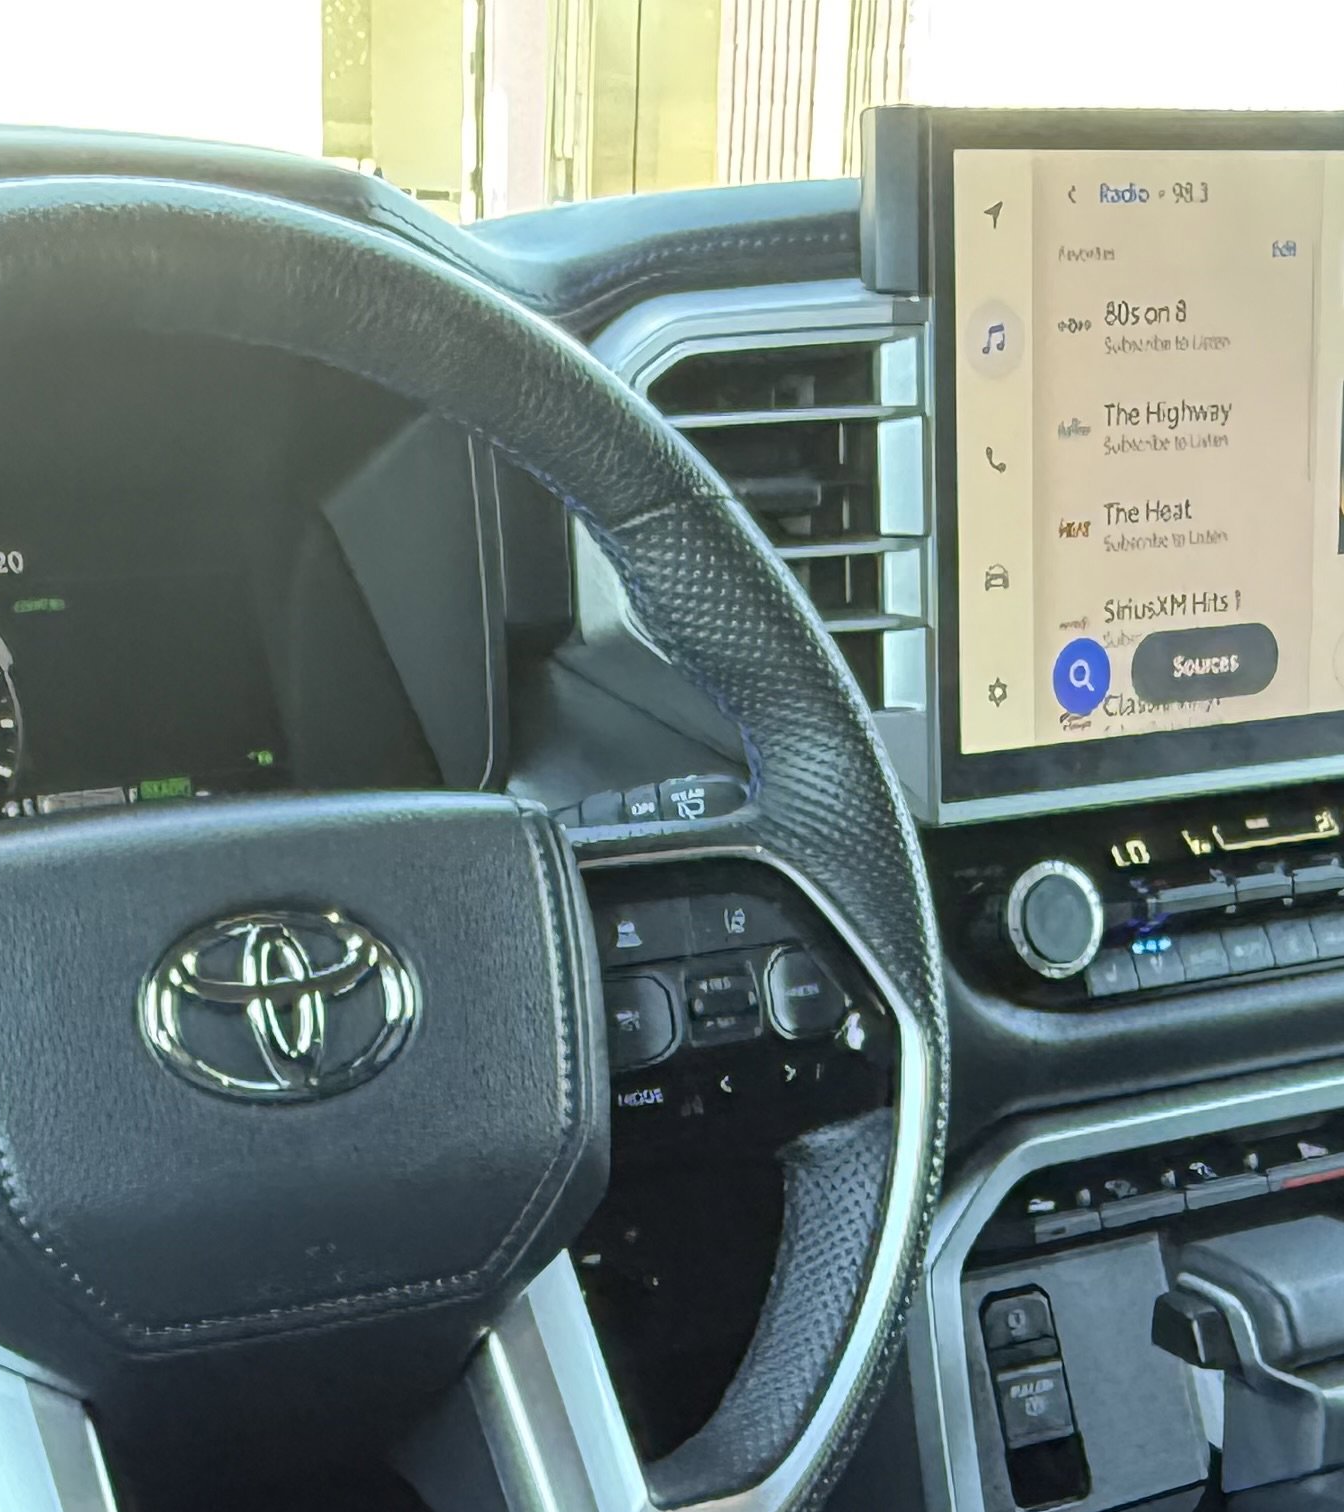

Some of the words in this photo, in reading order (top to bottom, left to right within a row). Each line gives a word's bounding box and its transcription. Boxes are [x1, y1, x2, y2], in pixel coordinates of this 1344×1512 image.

[1099, 181, 1150, 204] Radio
[1104, 300, 1141, 327] 80s
[1143, 305, 1171, 325] on
[1175, 299, 1188, 323] 8
[1104, 402, 1141, 427] The
[1146, 399, 1233, 429] Highway
[1104, 502, 1140, 527] The
[1145, 499, 1193, 524] Heat
[1104, 594, 1187, 624] SiriusXM
[1191, 592, 1229, 617] Hits
[1172, 654, 1240, 678] Sources
